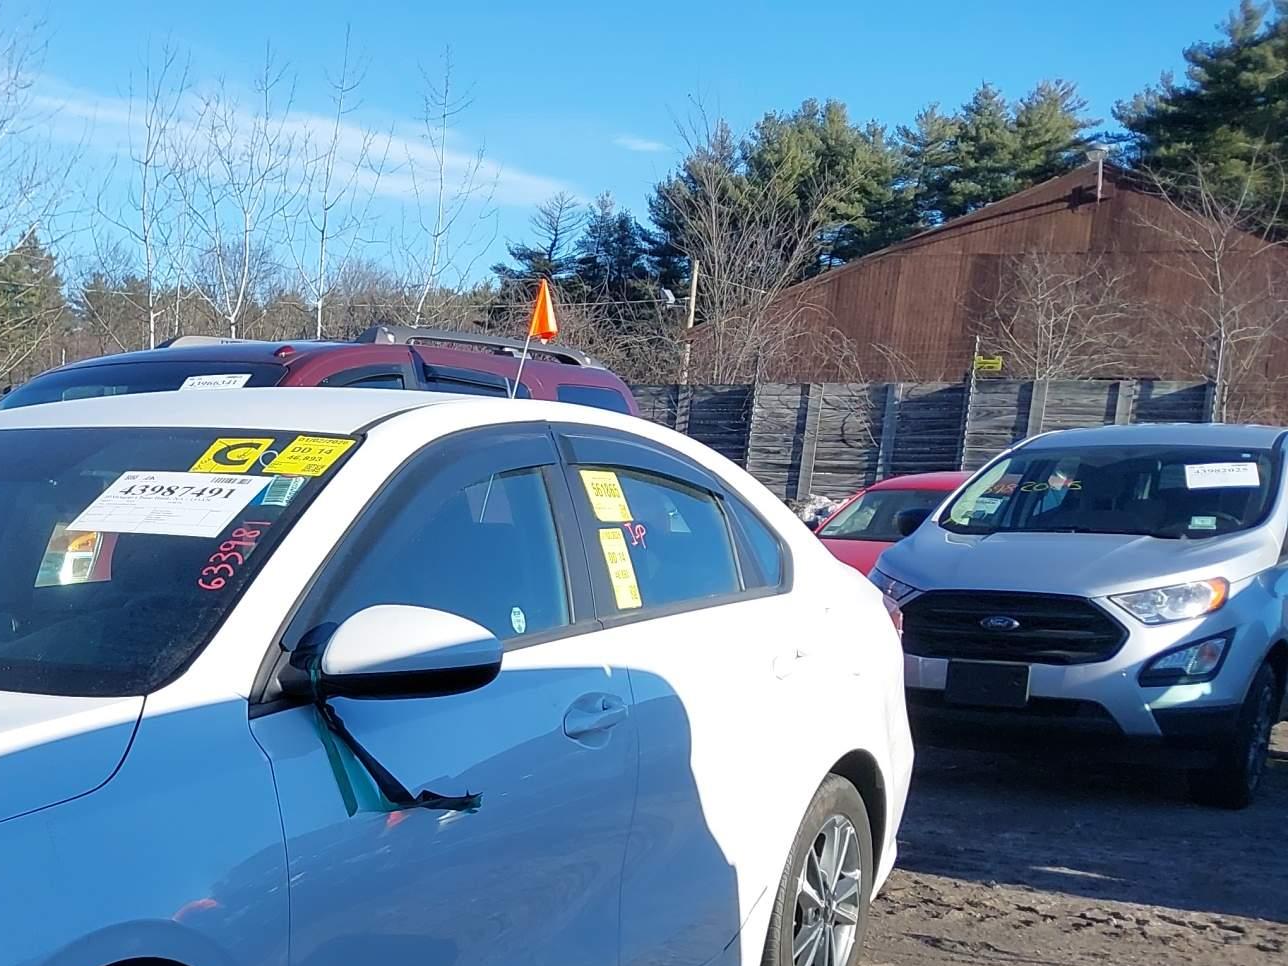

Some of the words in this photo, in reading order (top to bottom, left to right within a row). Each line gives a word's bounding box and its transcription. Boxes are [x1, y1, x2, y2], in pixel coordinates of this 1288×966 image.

[290, 446, 312, 454] DD
[317, 447, 334, 455] 14
[119, 483, 237, 501] 43987491
